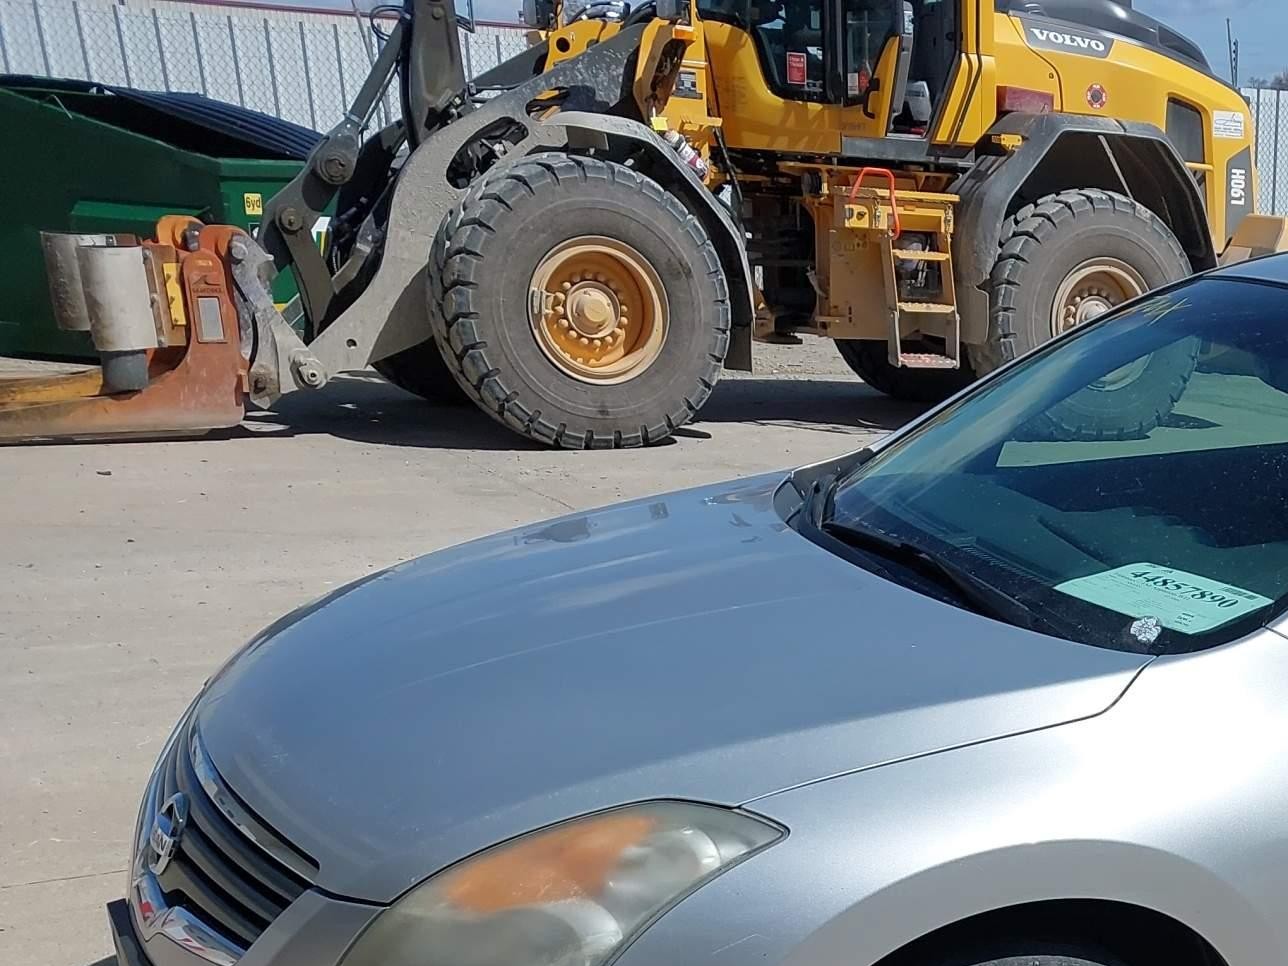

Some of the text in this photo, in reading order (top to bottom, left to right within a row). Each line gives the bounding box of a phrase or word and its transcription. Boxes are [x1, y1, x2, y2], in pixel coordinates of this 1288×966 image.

[1030, 28, 1105, 51] VOLVO
[1230, 168, 1246, 206] L90H
[245, 196, 261, 209] 6yd
[1130, 570, 1239, 608] 44857890
